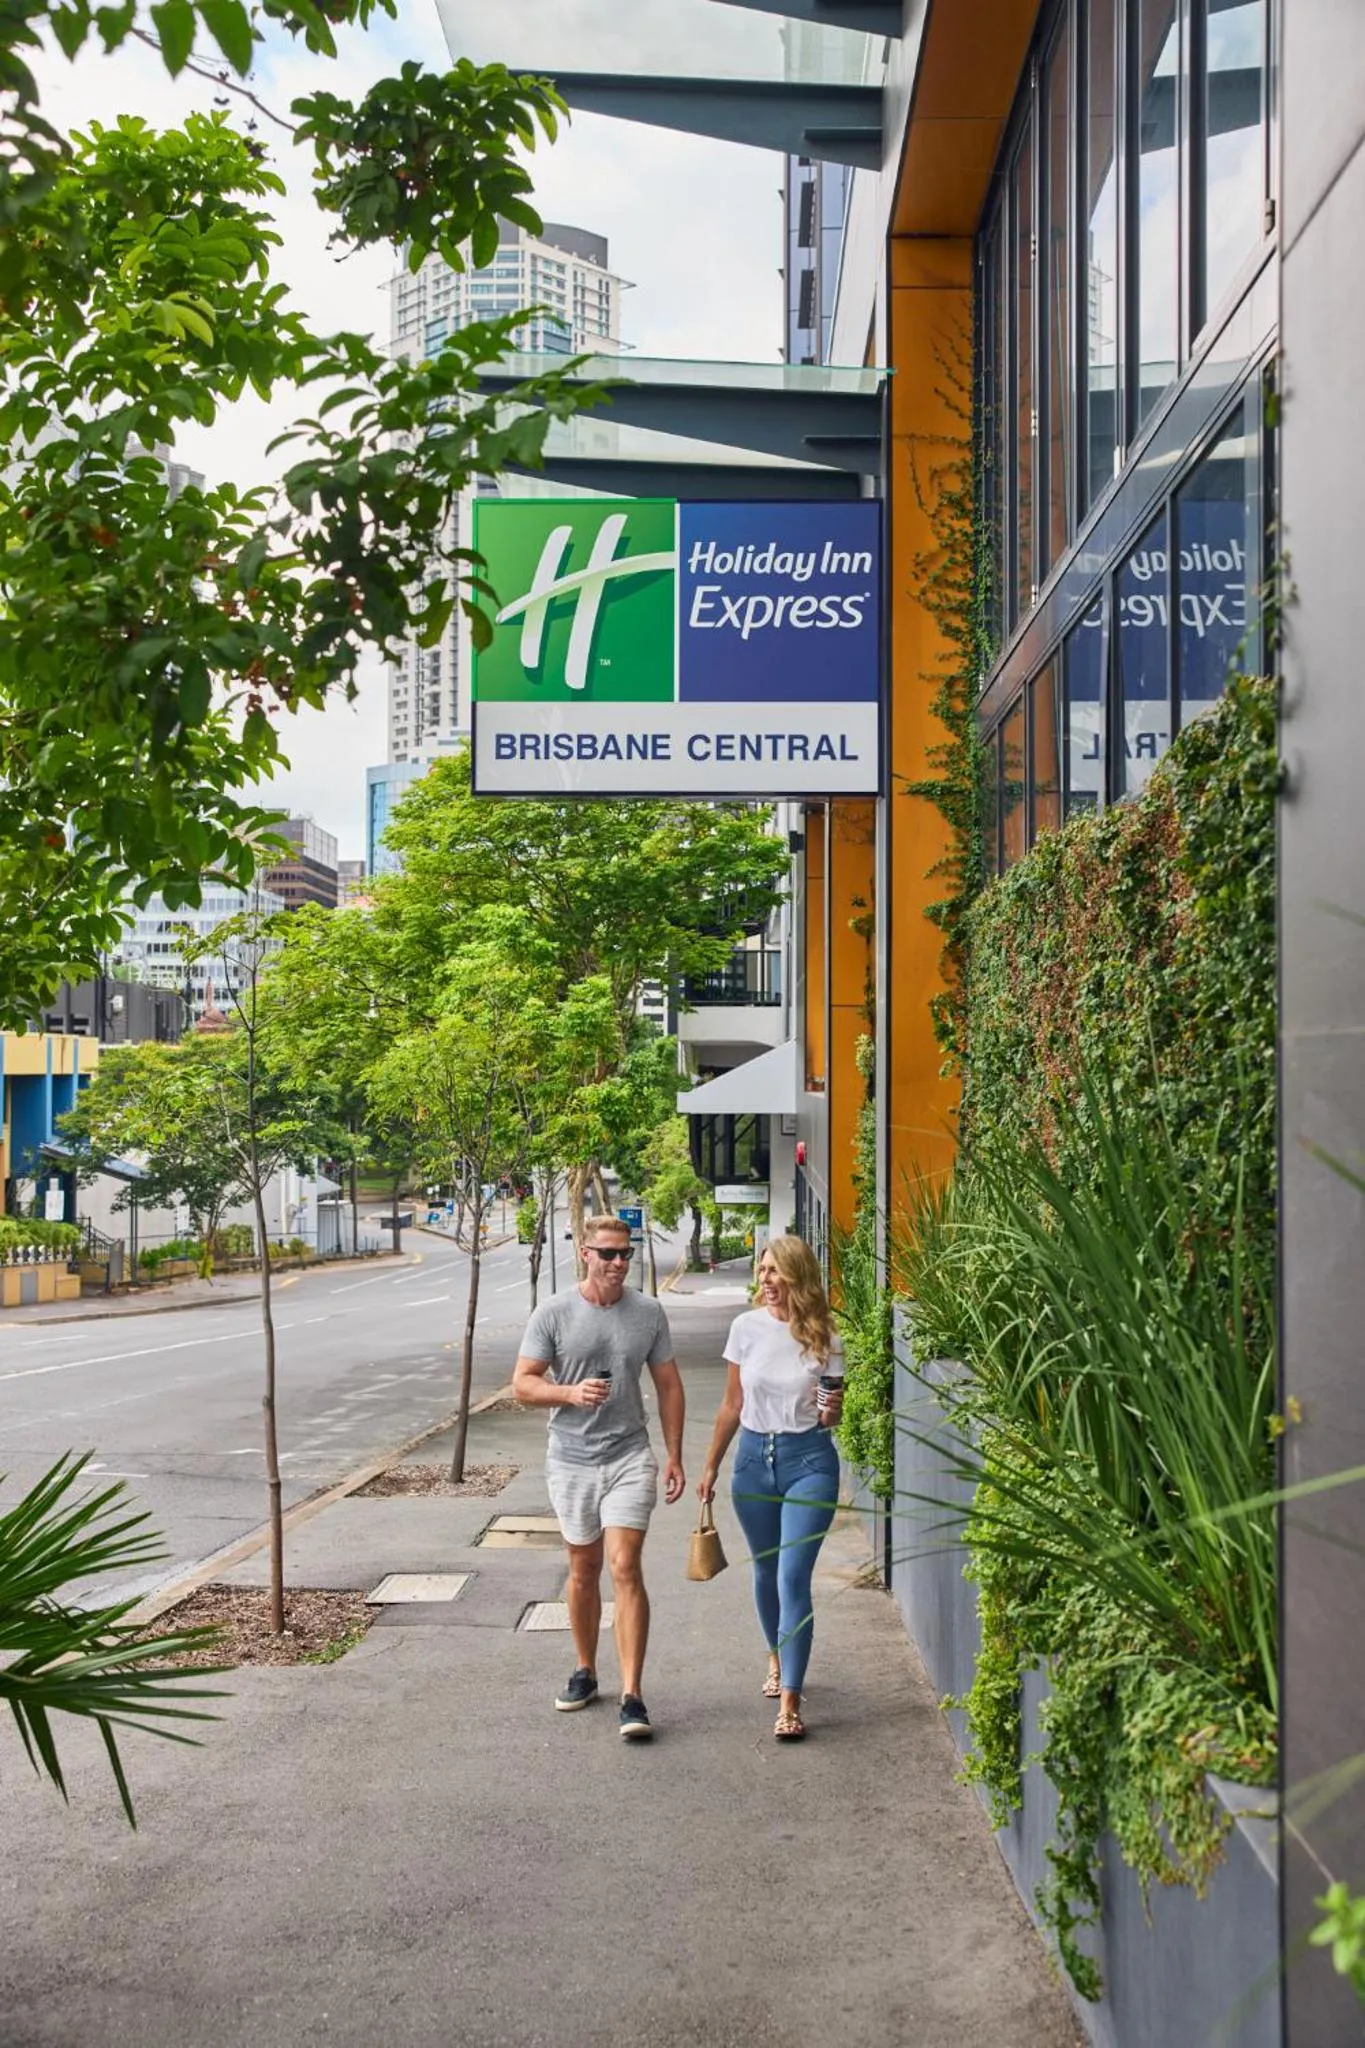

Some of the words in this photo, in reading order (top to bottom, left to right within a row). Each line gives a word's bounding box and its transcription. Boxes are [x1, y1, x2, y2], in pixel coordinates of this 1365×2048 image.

[688, 541, 816, 582] Holiday
[820, 541, 873, 574] Inn
[689, 585, 865, 640] Express
[494, 733, 671, 761] BRISBANE
[687, 734, 859, 761] CENTRAL
